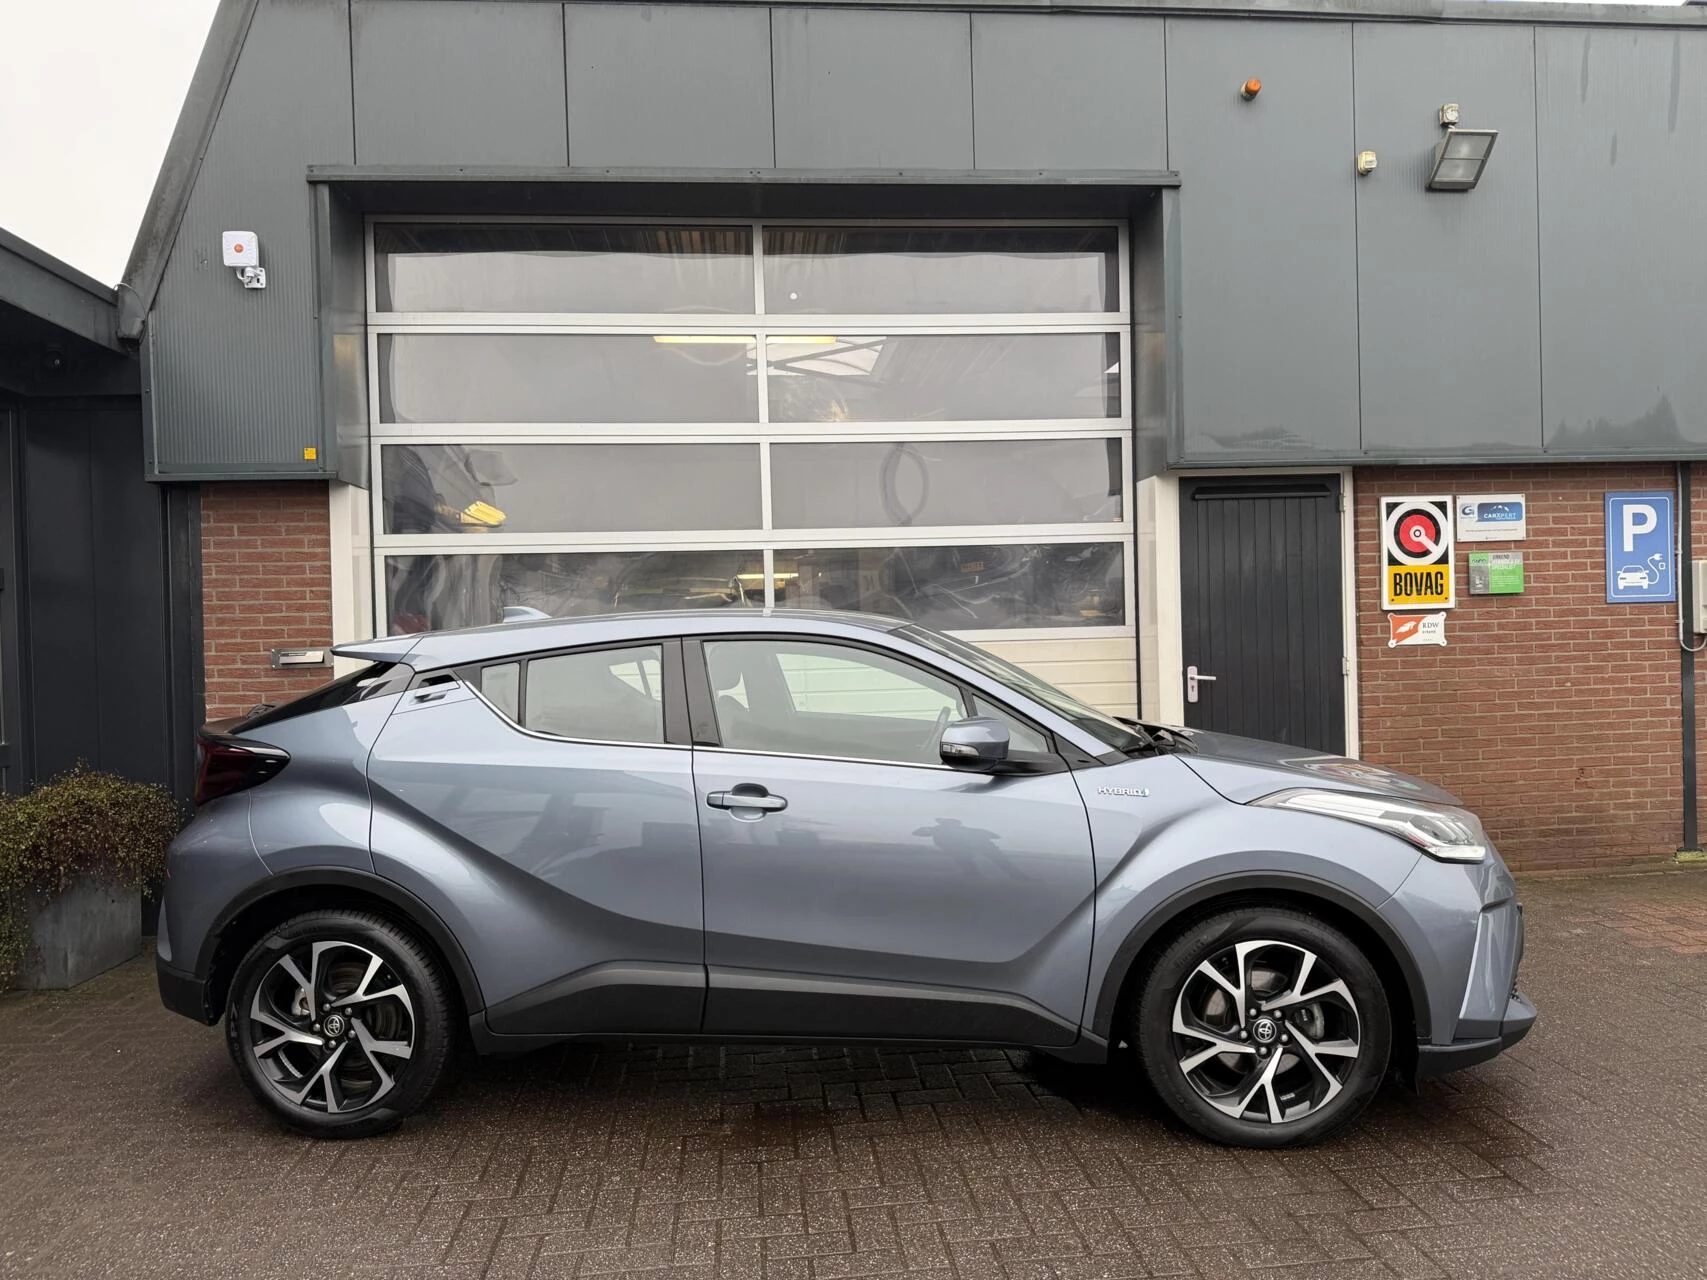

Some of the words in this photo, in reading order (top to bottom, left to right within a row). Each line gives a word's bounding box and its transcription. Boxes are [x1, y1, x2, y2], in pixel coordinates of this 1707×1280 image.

[1622, 504, 1657, 552] P
[1393, 571, 1444, 597] BOVAG
[1097, 786, 1143, 796] HYBRID
